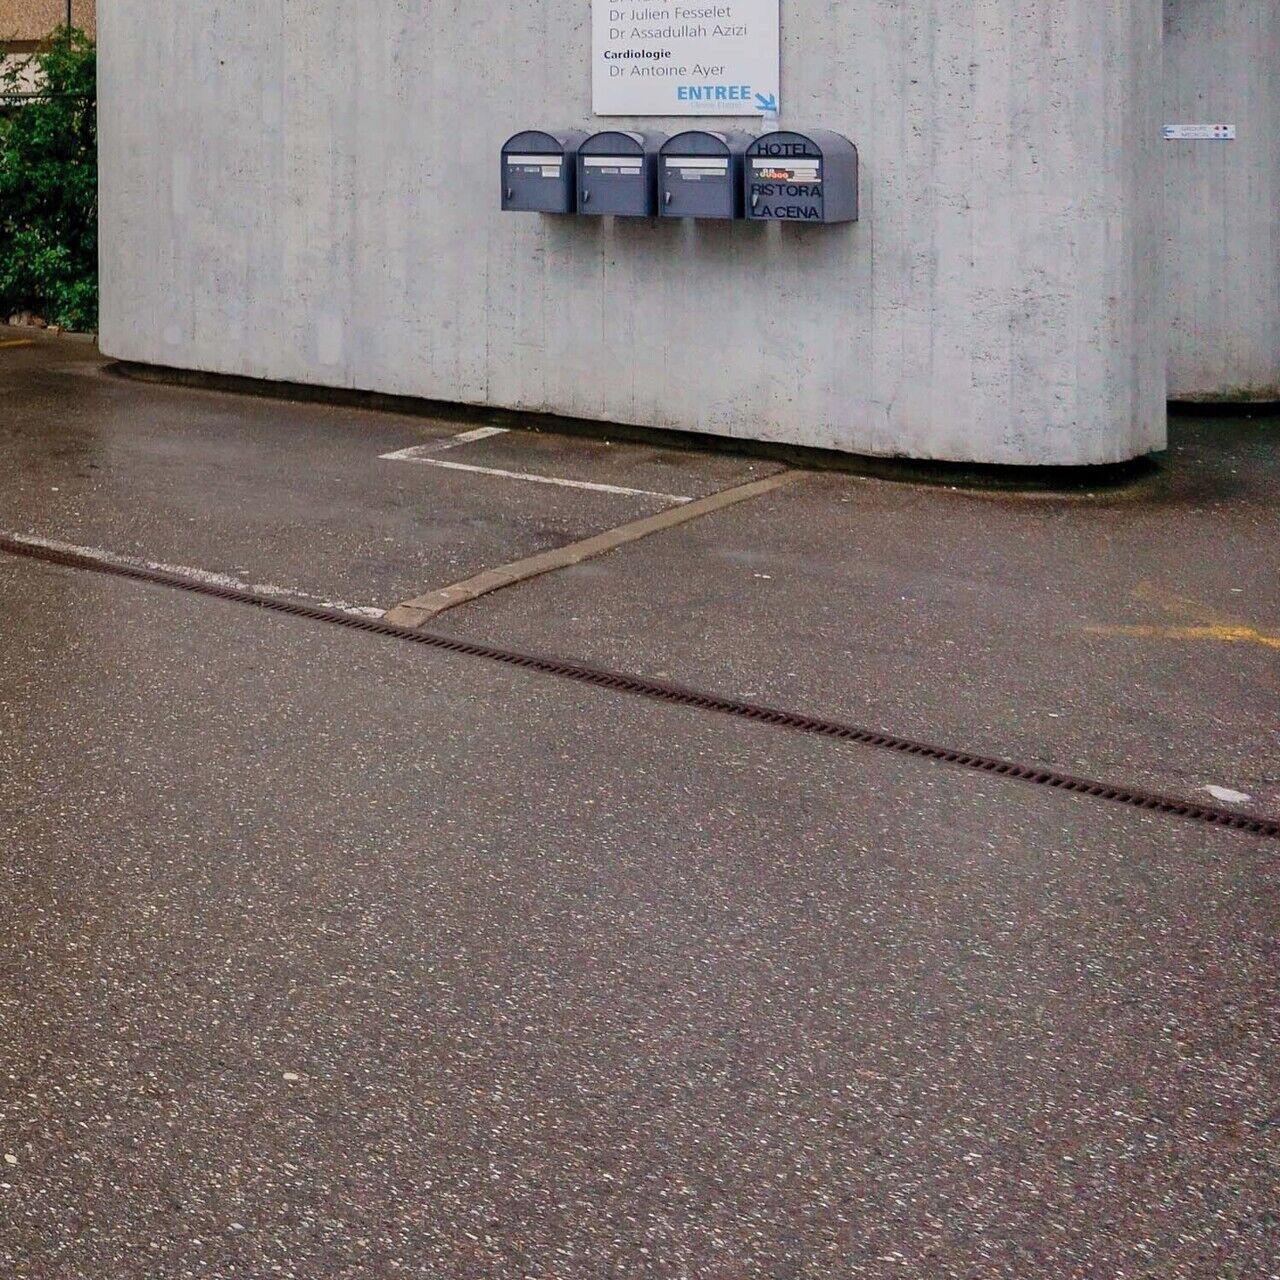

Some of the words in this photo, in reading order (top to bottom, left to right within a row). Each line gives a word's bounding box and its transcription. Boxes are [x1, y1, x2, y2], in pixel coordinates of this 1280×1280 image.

[609, 9, 625, 22] Dr
[630, 8, 669, 21] Julien
[675, 6, 731, 19] Fesselet
[609, 27, 625, 40] Dr
[630, 25, 707, 39] Assadullah
[712, 23, 748, 37] Azizi
[604, 48, 671, 61] Cardiologie
[609, 65, 625, 77] Dr
[630, 64, 687, 77] Antoine
[692, 63, 726, 79] Ayer
[677, 85, 751, 101] ENTREE
[757, 143, 811, 156] HOTEL
[751, 183, 822, 197] RISTORA
[752, 205, 773, 218] LA
[774, 205, 820, 219] CENA
